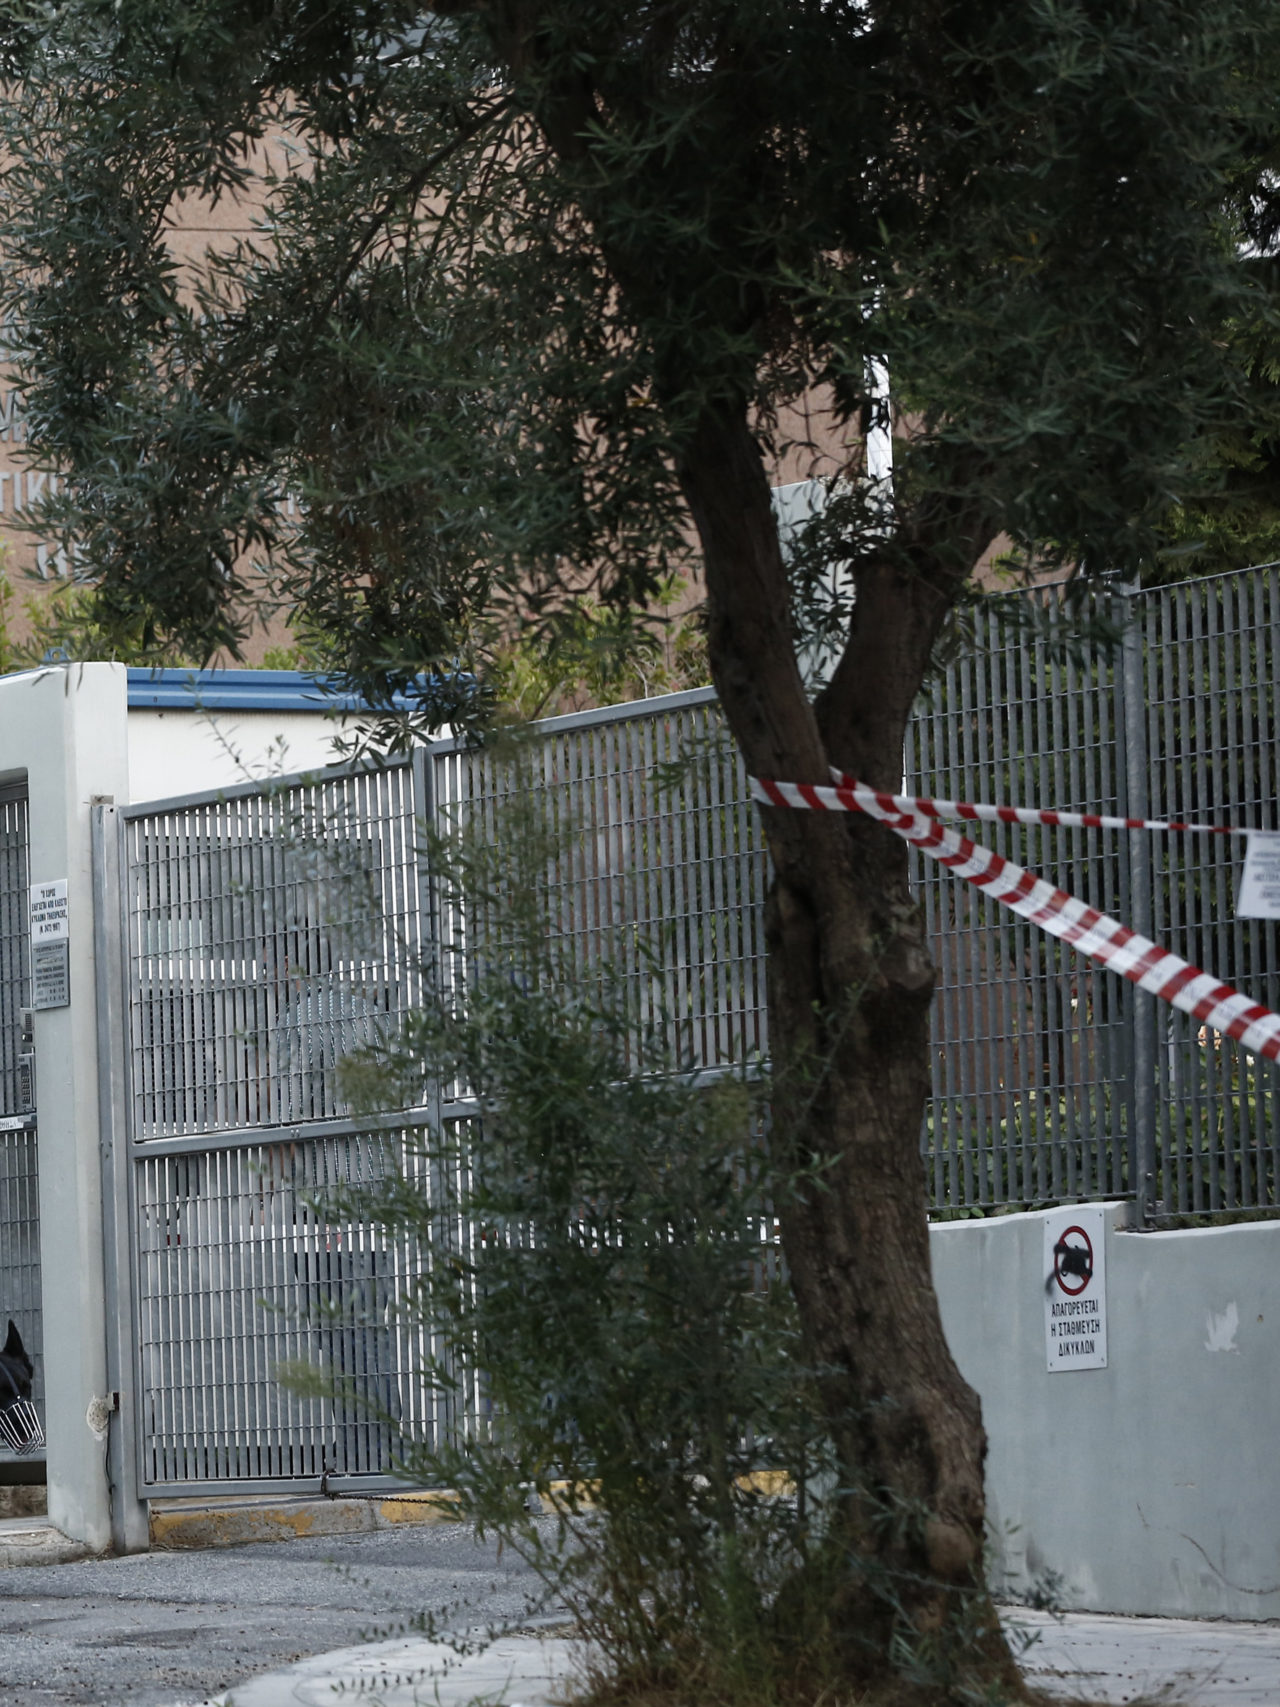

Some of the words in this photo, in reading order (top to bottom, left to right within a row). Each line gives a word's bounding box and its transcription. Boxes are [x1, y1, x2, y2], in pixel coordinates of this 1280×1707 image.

[1051, 1299, 1099, 1317] ΑΠΑΓΟΡΕΥΕΤΑΙ
[1051, 1323, 1057, 1337] Η
[1058, 1319, 1101, 1336] ΣΤΑΘΜΕΥΣΗ
[1058, 1339, 1095, 1357] ΔΙΚΥΚΛΩΝ
